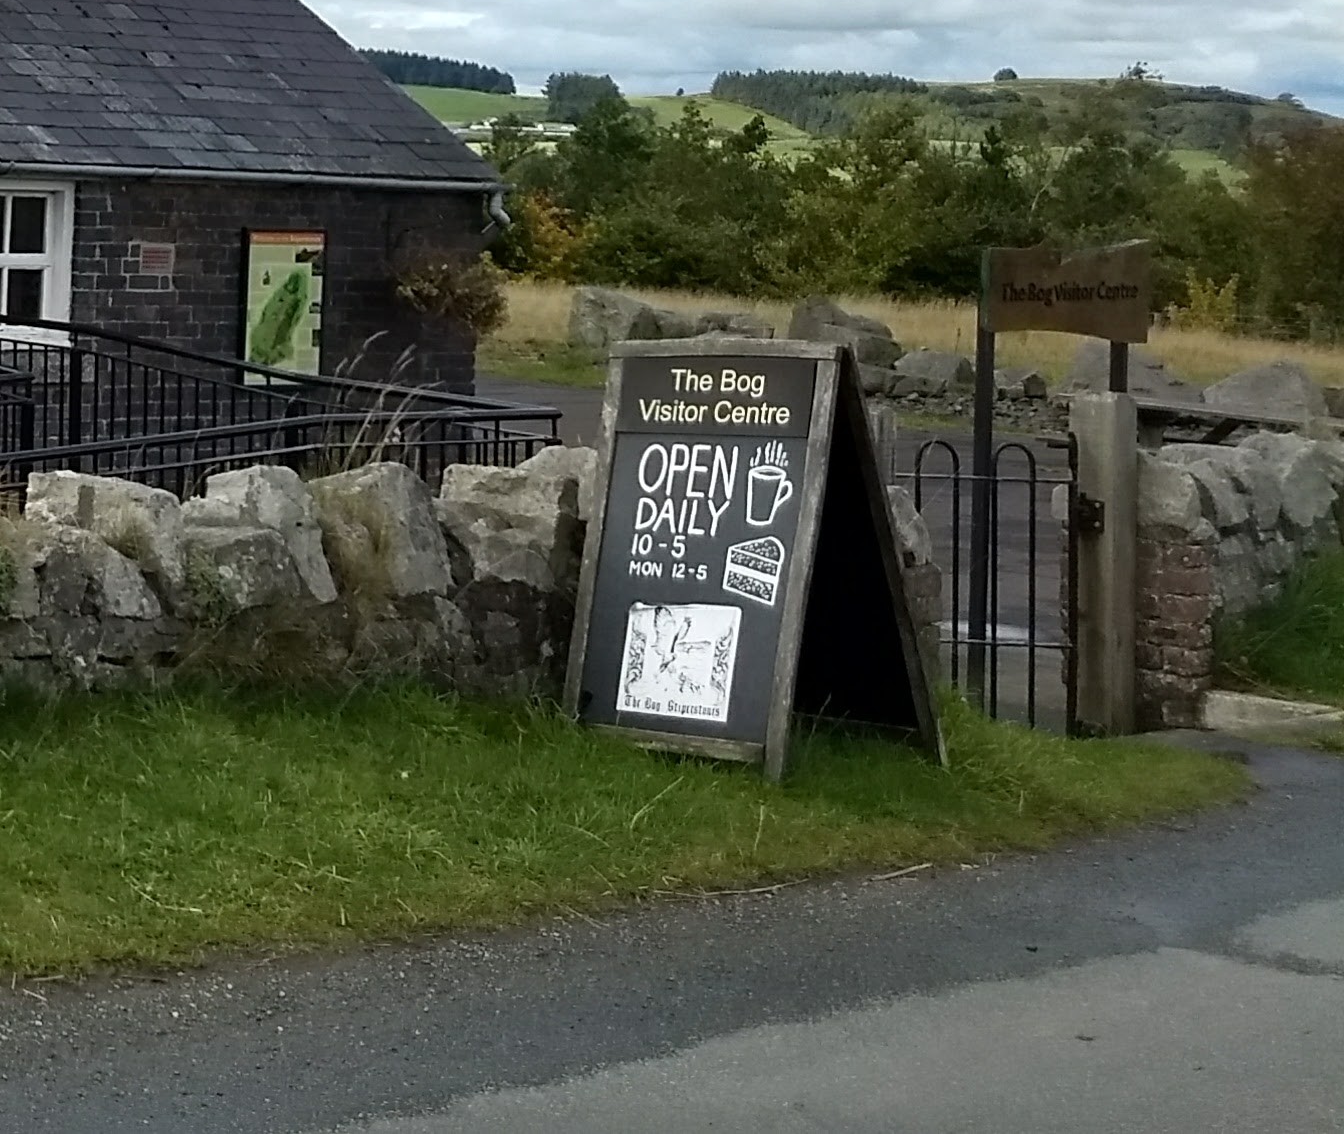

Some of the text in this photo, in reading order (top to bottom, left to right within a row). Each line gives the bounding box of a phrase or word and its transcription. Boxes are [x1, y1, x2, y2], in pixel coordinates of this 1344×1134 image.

[1001, 281, 1138, 306] The Bog Visitor Centre
[671, 369, 765, 398] The Bog
[639, 399, 790, 424] Visitor Centre
[638, 443, 739, 500] OPEN
[635, 497, 730, 537] DAILY
[629, 560, 663, 577] MON
